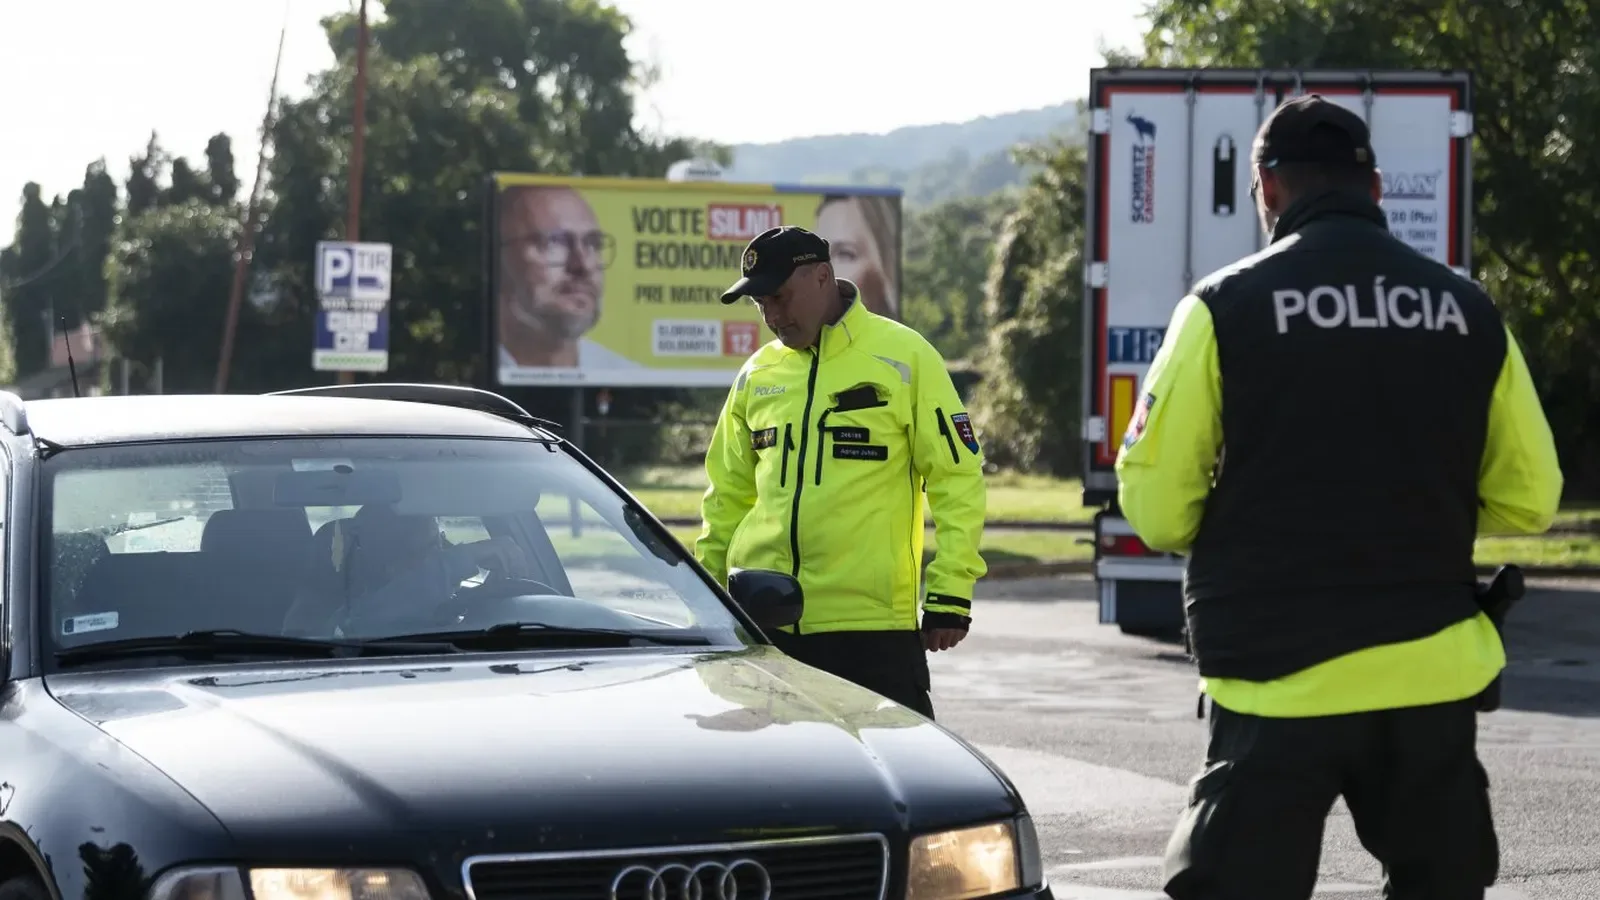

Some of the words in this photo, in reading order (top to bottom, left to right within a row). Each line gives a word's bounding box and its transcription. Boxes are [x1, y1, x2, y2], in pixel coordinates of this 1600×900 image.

[1131, 144, 1145, 224] SCHMITZ
[324, 249, 352, 294] P
[792, 252, 818, 263] POLÍCIA
[1272, 274, 1469, 336] POLÍCIA
[732, 333, 753, 353] 12
[1112, 328, 1163, 362] TIR
[754, 384, 786, 397] POLÍCIA
